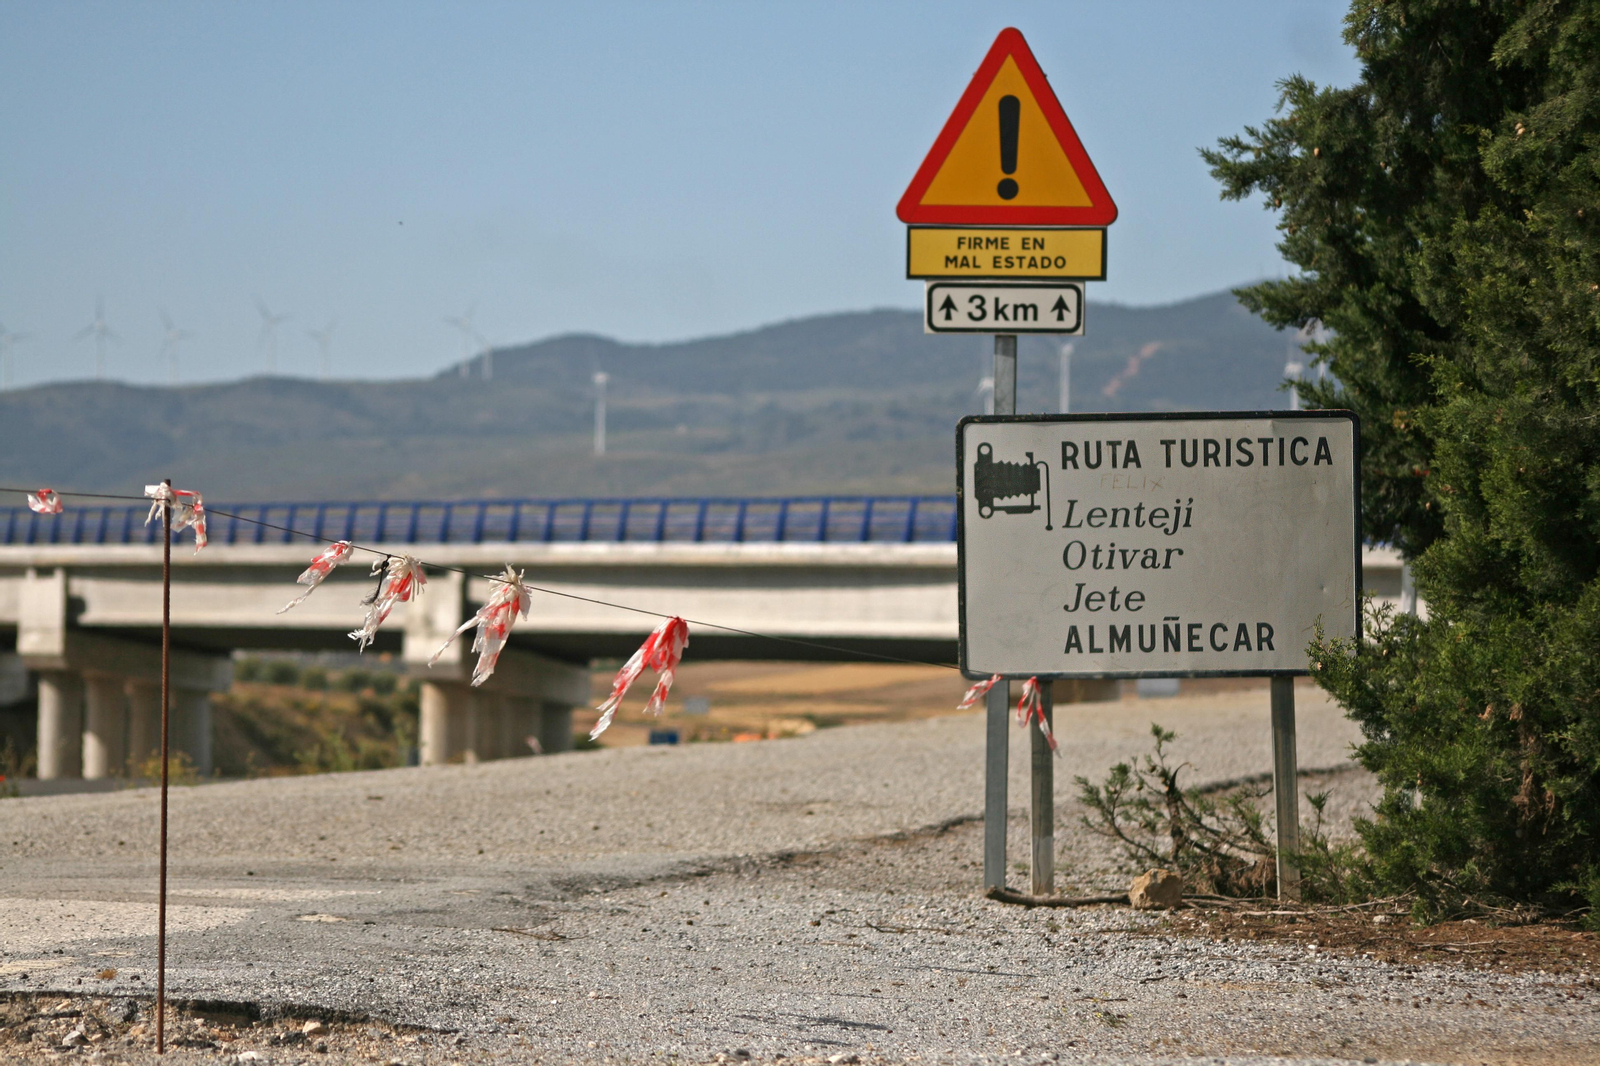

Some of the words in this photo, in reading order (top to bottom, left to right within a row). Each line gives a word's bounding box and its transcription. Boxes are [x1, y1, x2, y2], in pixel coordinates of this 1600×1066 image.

[957, 236, 1010, 250] FIRME
[1021, 237, 1045, 251] EN
[944, 255, 982, 269] MAL
[992, 255, 1067, 269] ESTADO
[1061, 440, 1141, 470] RUTA
[1160, 437, 1333, 468] TURISTICA
[1062, 539, 1184, 571] Otivar
[1063, 582, 1146, 612] Jete
[1064, 616, 1275, 655] ALMUÑECAR
